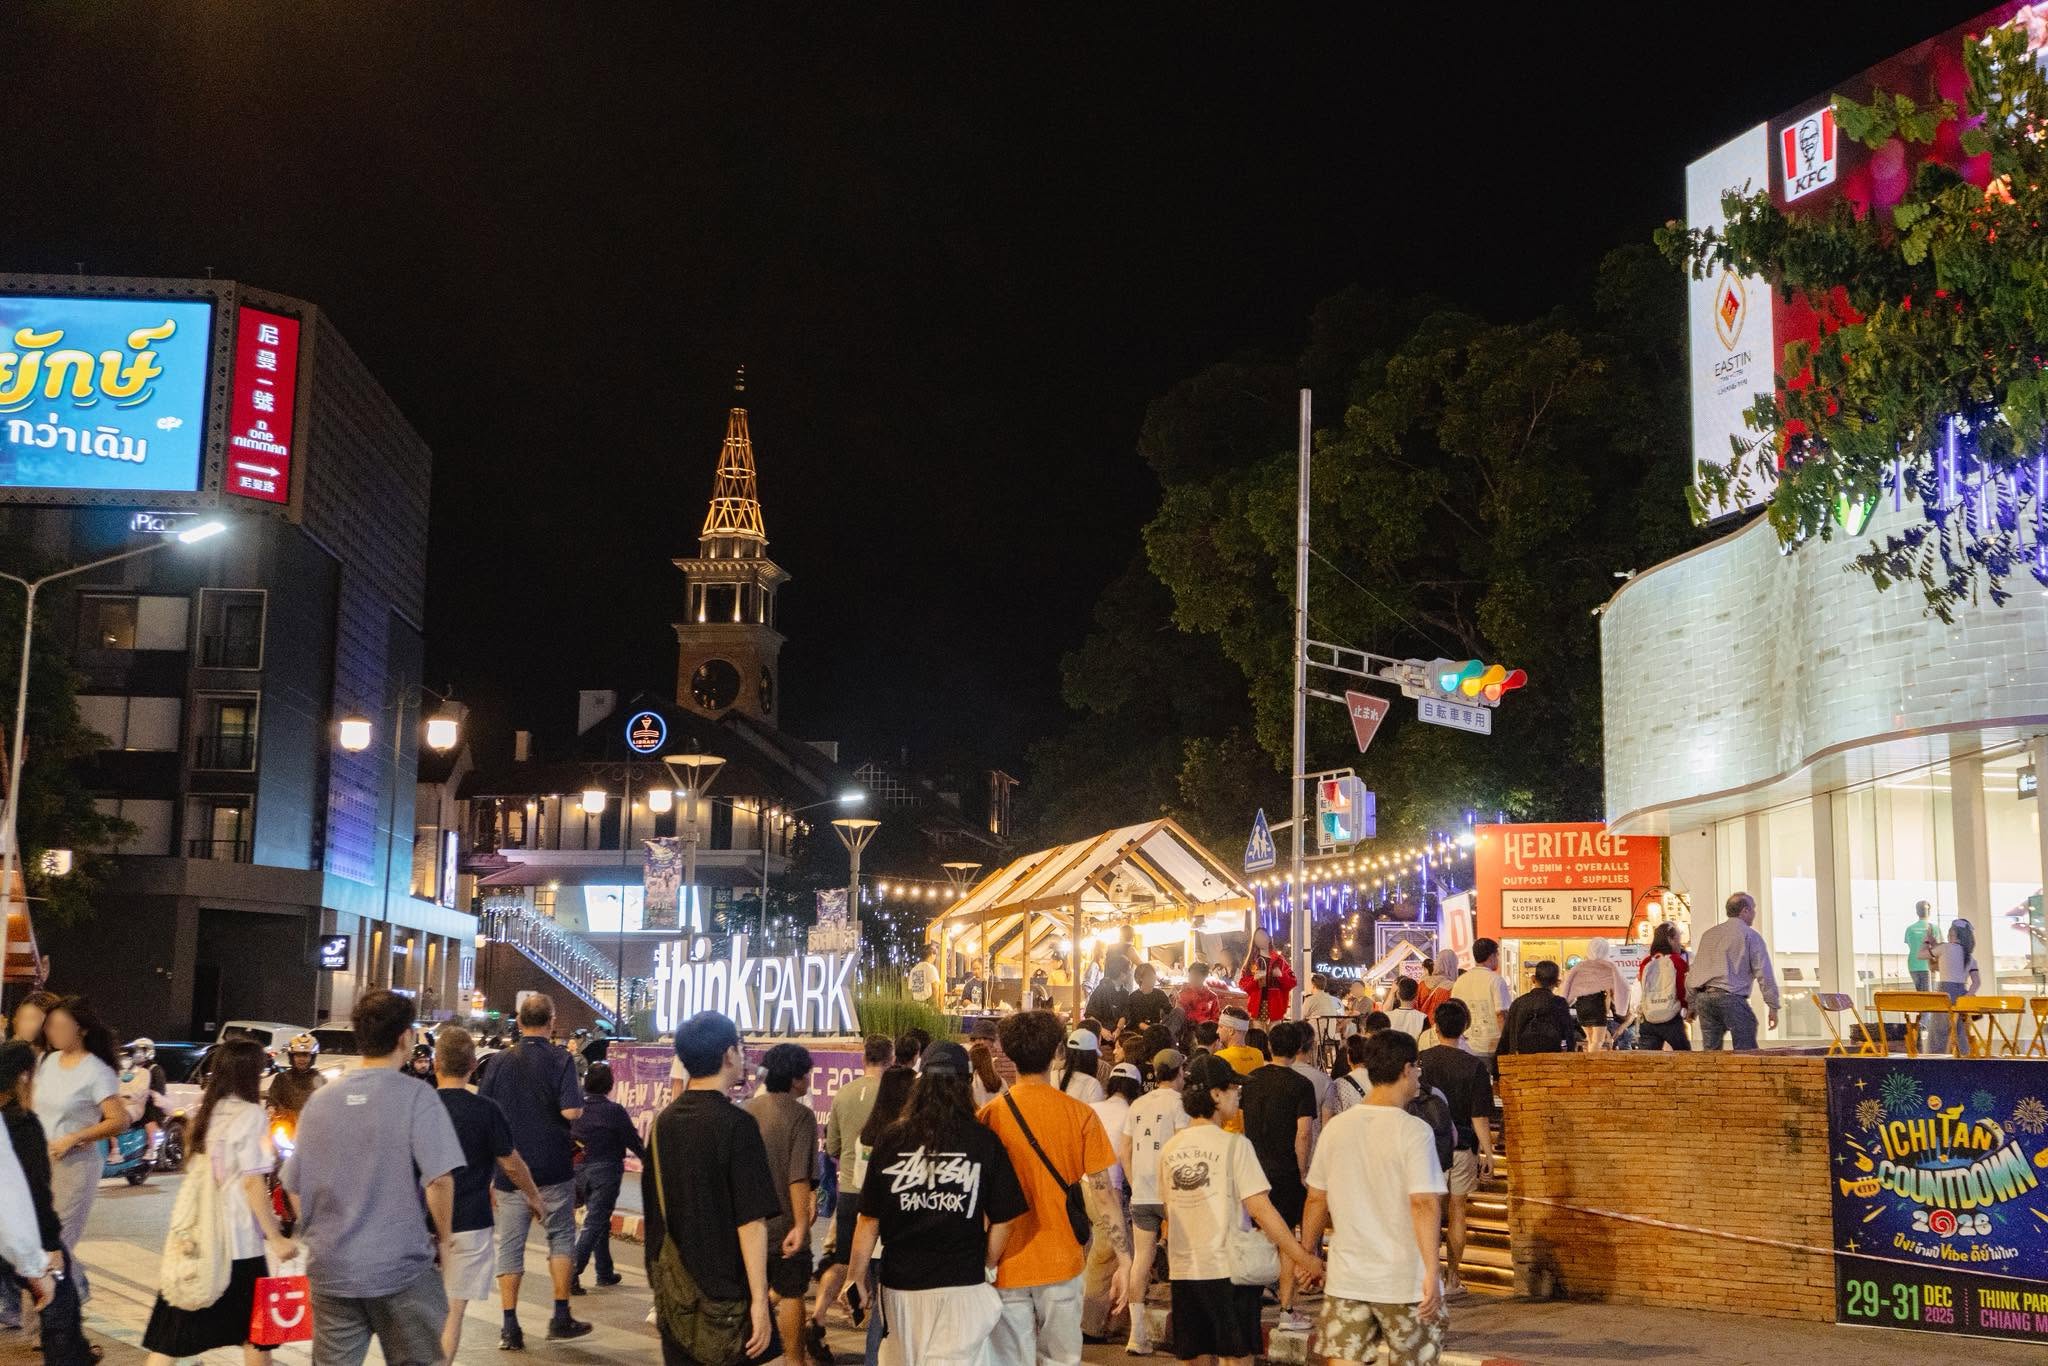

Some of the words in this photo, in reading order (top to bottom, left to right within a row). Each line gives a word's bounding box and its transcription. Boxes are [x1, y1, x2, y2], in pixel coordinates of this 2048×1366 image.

[1795, 166, 1828, 194] KFC
[1715, 351, 1752, 377] EASTIN
[233, 436, 287, 456] nimman
[249, 429, 274, 442] one
[1353, 705, 1379, 721] 止まれ
[1424, 702, 1485, 728] 自転車専用
[1504, 831, 1629, 870] HERITAGE
[1532, 863, 1562, 872] DENIM
[1575, 863, 1630, 872] OVERALLS
[1503, 875, 1548, 885] OUTPOST
[1582, 875, 1630, 884] SUPPLIES
[1572, 896, 1623, 904] ARMY-ITEMS
[1572, 913, 1594, 921] DAILY
[1596, 913, 1620, 921] WEAR
[1316, 963, 1331, 972] The
[616, 1081, 648, 1107] NEW
[1879, 1104, 1992, 1161] ICHITAN
[1878, 1140, 2039, 1209] COUNTDOWN
[900, 1191, 967, 1212] BANGKOK
[1940, 1242, 1969, 1262] Vibe
[1846, 1279, 1920, 1321] 29-31
[1923, 1284, 1953, 1308] DEC
[1978, 1288, 2020, 1310] THINK
[1924, 1306, 1954, 1324] 2025
[1980, 1309, 2031, 1332] CHIANG
